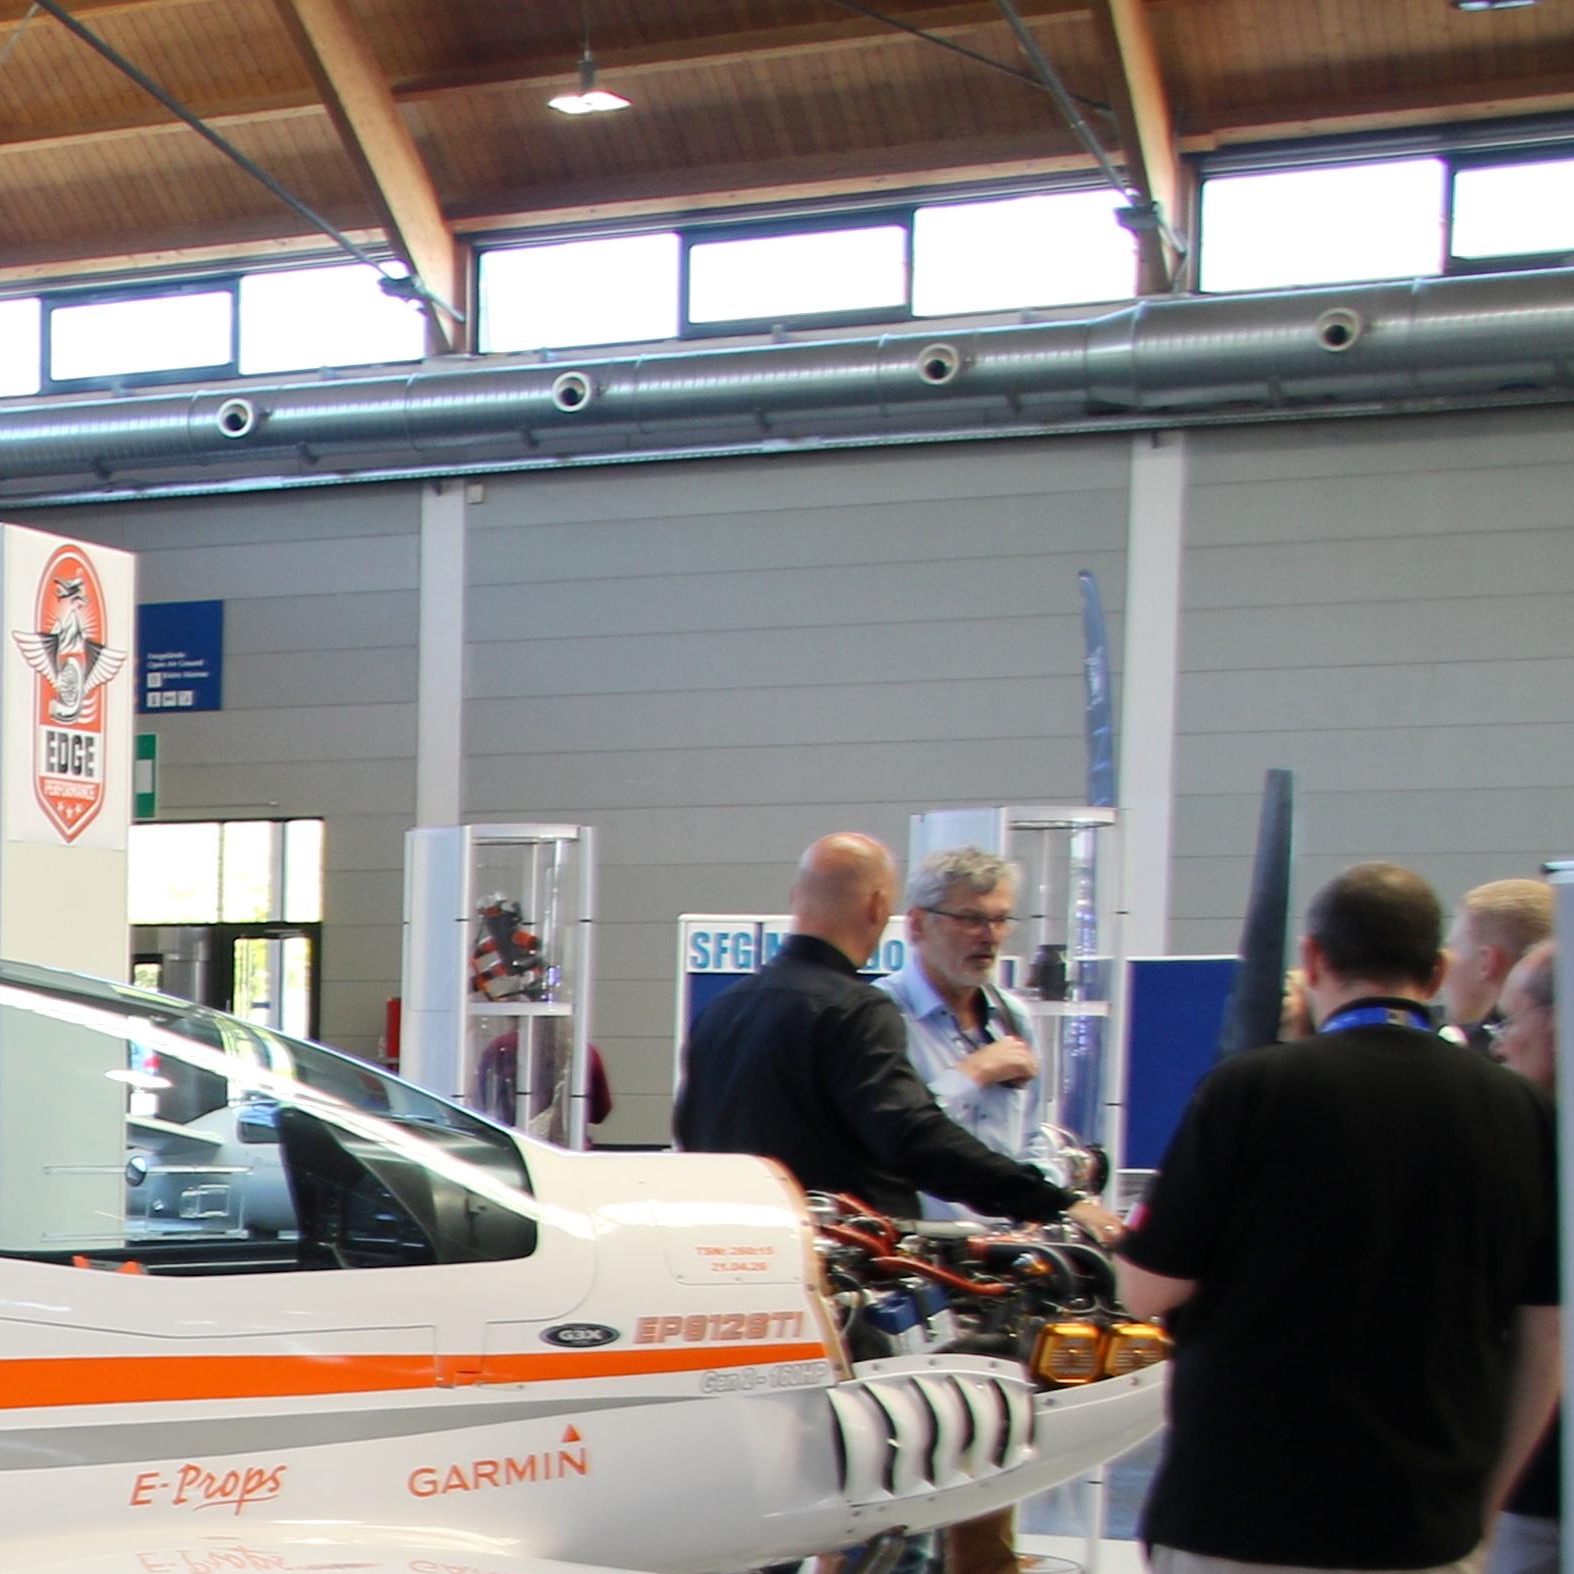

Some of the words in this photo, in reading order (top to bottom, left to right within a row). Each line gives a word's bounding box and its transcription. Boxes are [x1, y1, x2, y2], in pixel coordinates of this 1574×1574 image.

[46, 730, 95, 777] EDGE
[690, 931, 752, 970] SFG
[129, 1462, 287, 1516] E-Props
[408, 1447, 587, 1499] GARMIN
